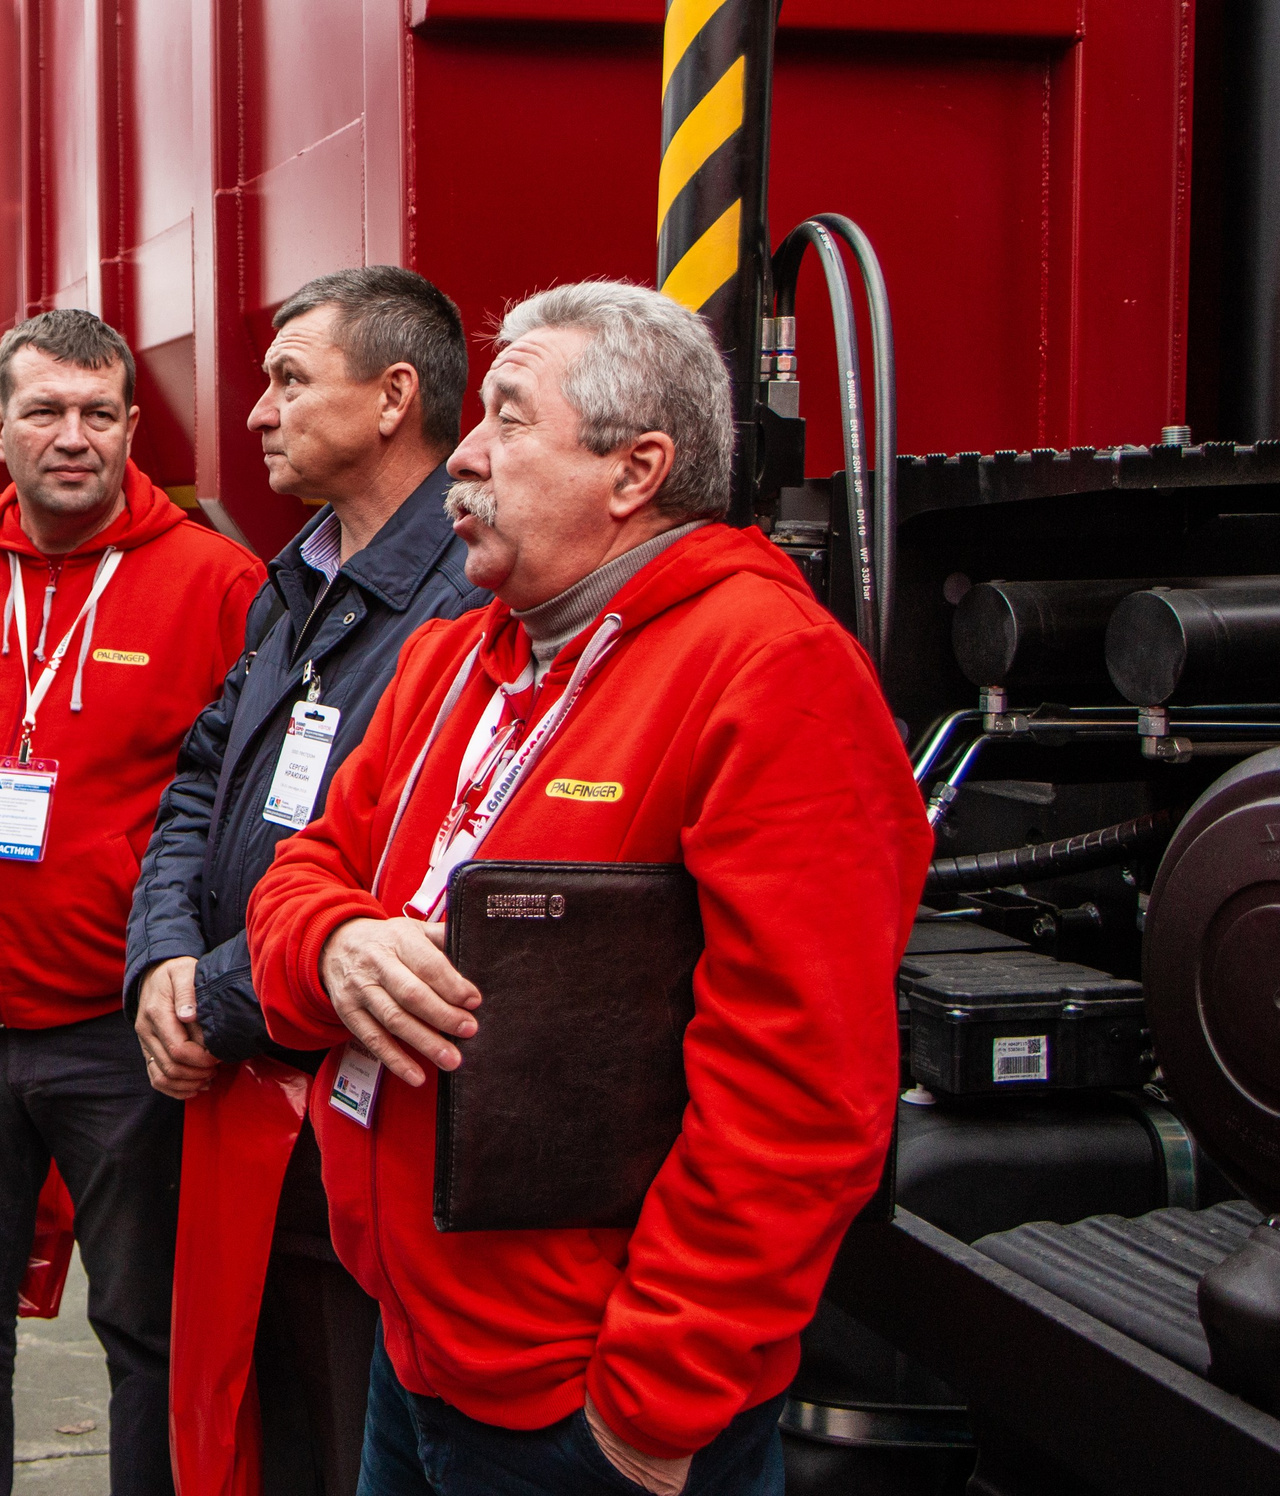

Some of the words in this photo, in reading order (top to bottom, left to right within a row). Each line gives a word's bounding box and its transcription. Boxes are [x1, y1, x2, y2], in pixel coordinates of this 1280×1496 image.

[846, 379, 857, 409] SVAROG
[849, 419, 859, 432] EN
[852, 455, 862, 473] 2SN
[856, 509, 865, 523] DN
[858, 526, 867, 536] 10
[859, 547, 869, 563] WP
[861, 567, 870, 584] 330
[862, 585, 871, 601] bar
[96, 651, 145, 663] PALFINGER
[288, 762, 309, 773] СЕРГЕЙ
[549, 781, 618, 798] PALFINGER
